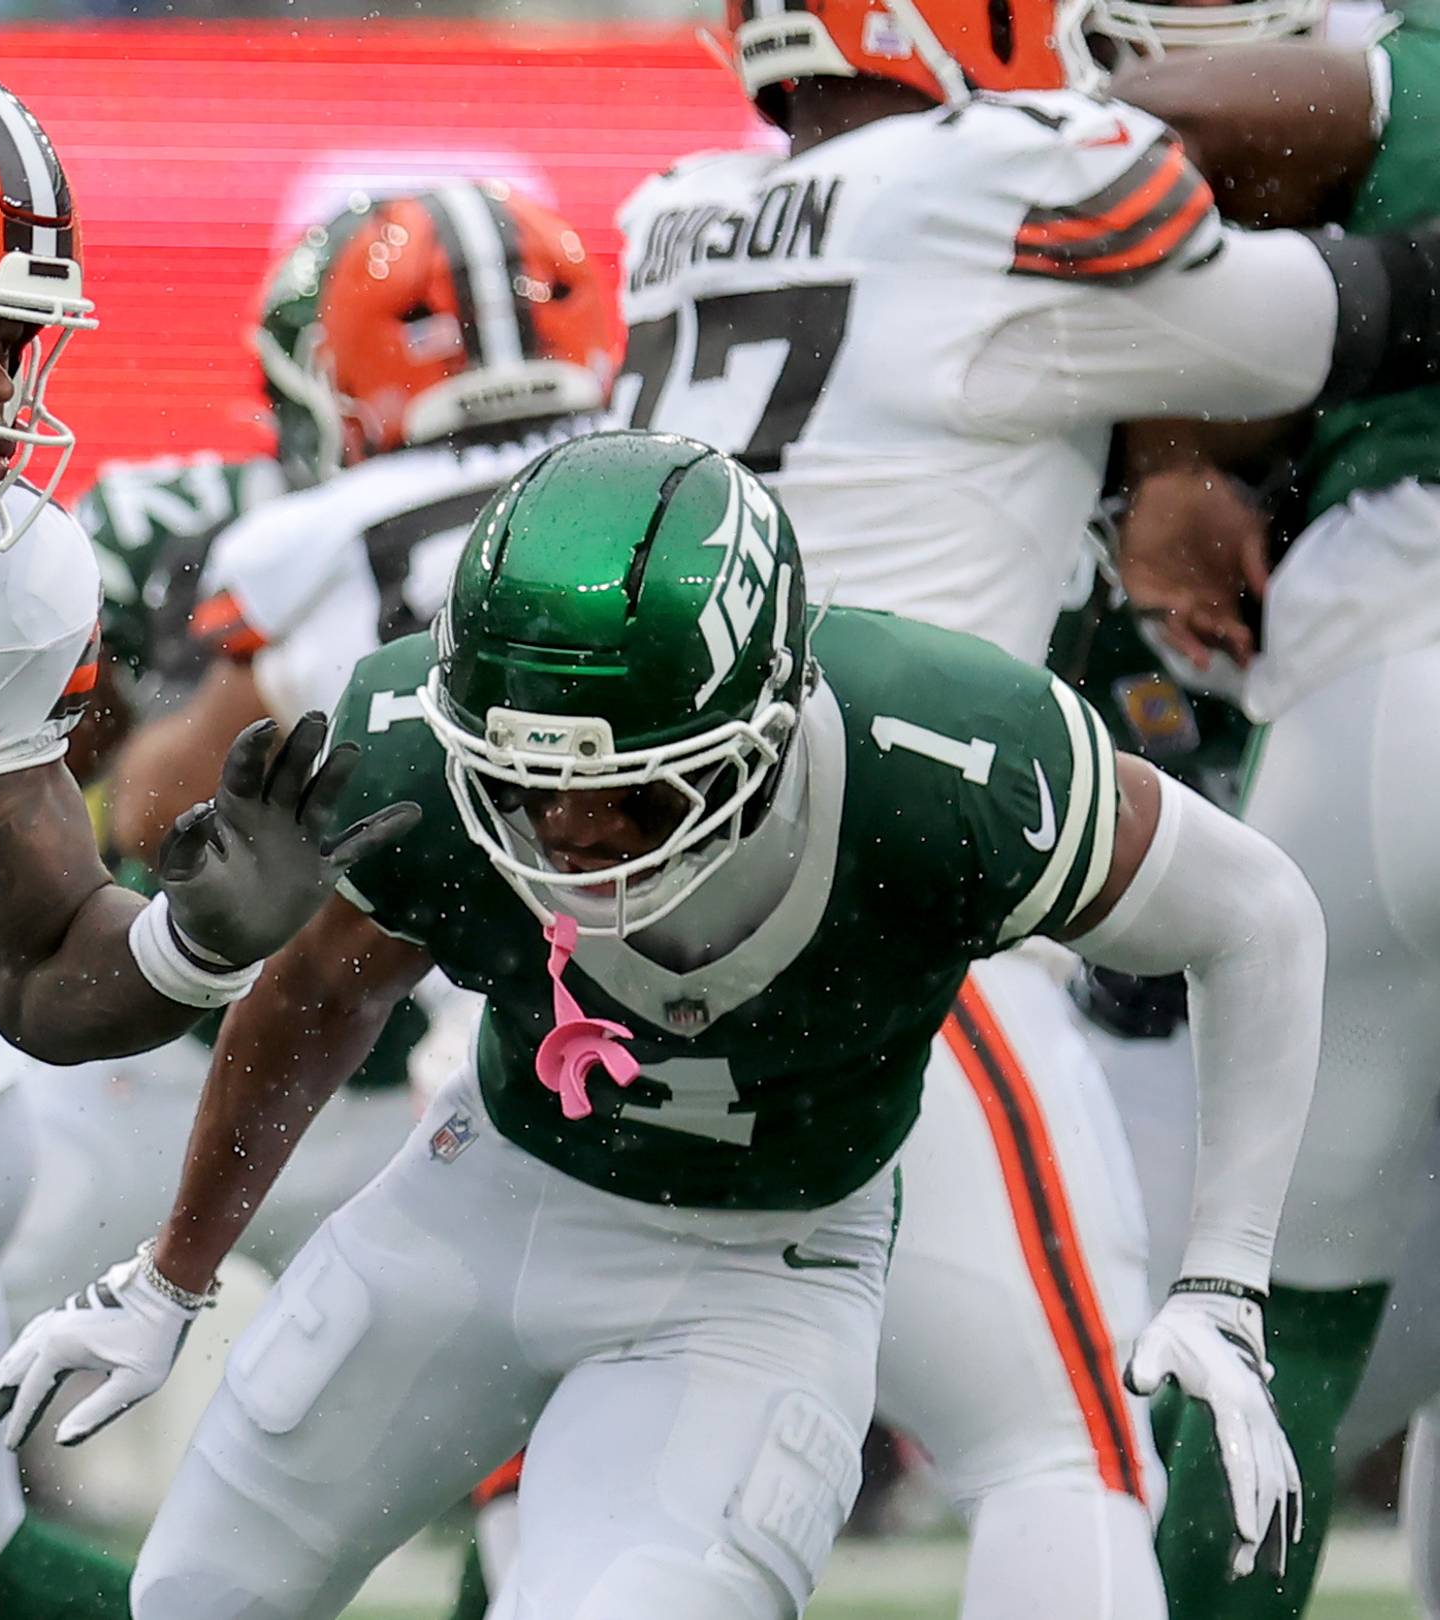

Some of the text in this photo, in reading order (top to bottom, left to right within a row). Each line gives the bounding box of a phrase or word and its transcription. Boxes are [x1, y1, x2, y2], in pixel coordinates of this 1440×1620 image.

[694, 458, 779, 712] JETS
[526, 731, 567, 745] NY
[870, 714, 998, 786] 1
[619, 1057, 757, 1147] 1
